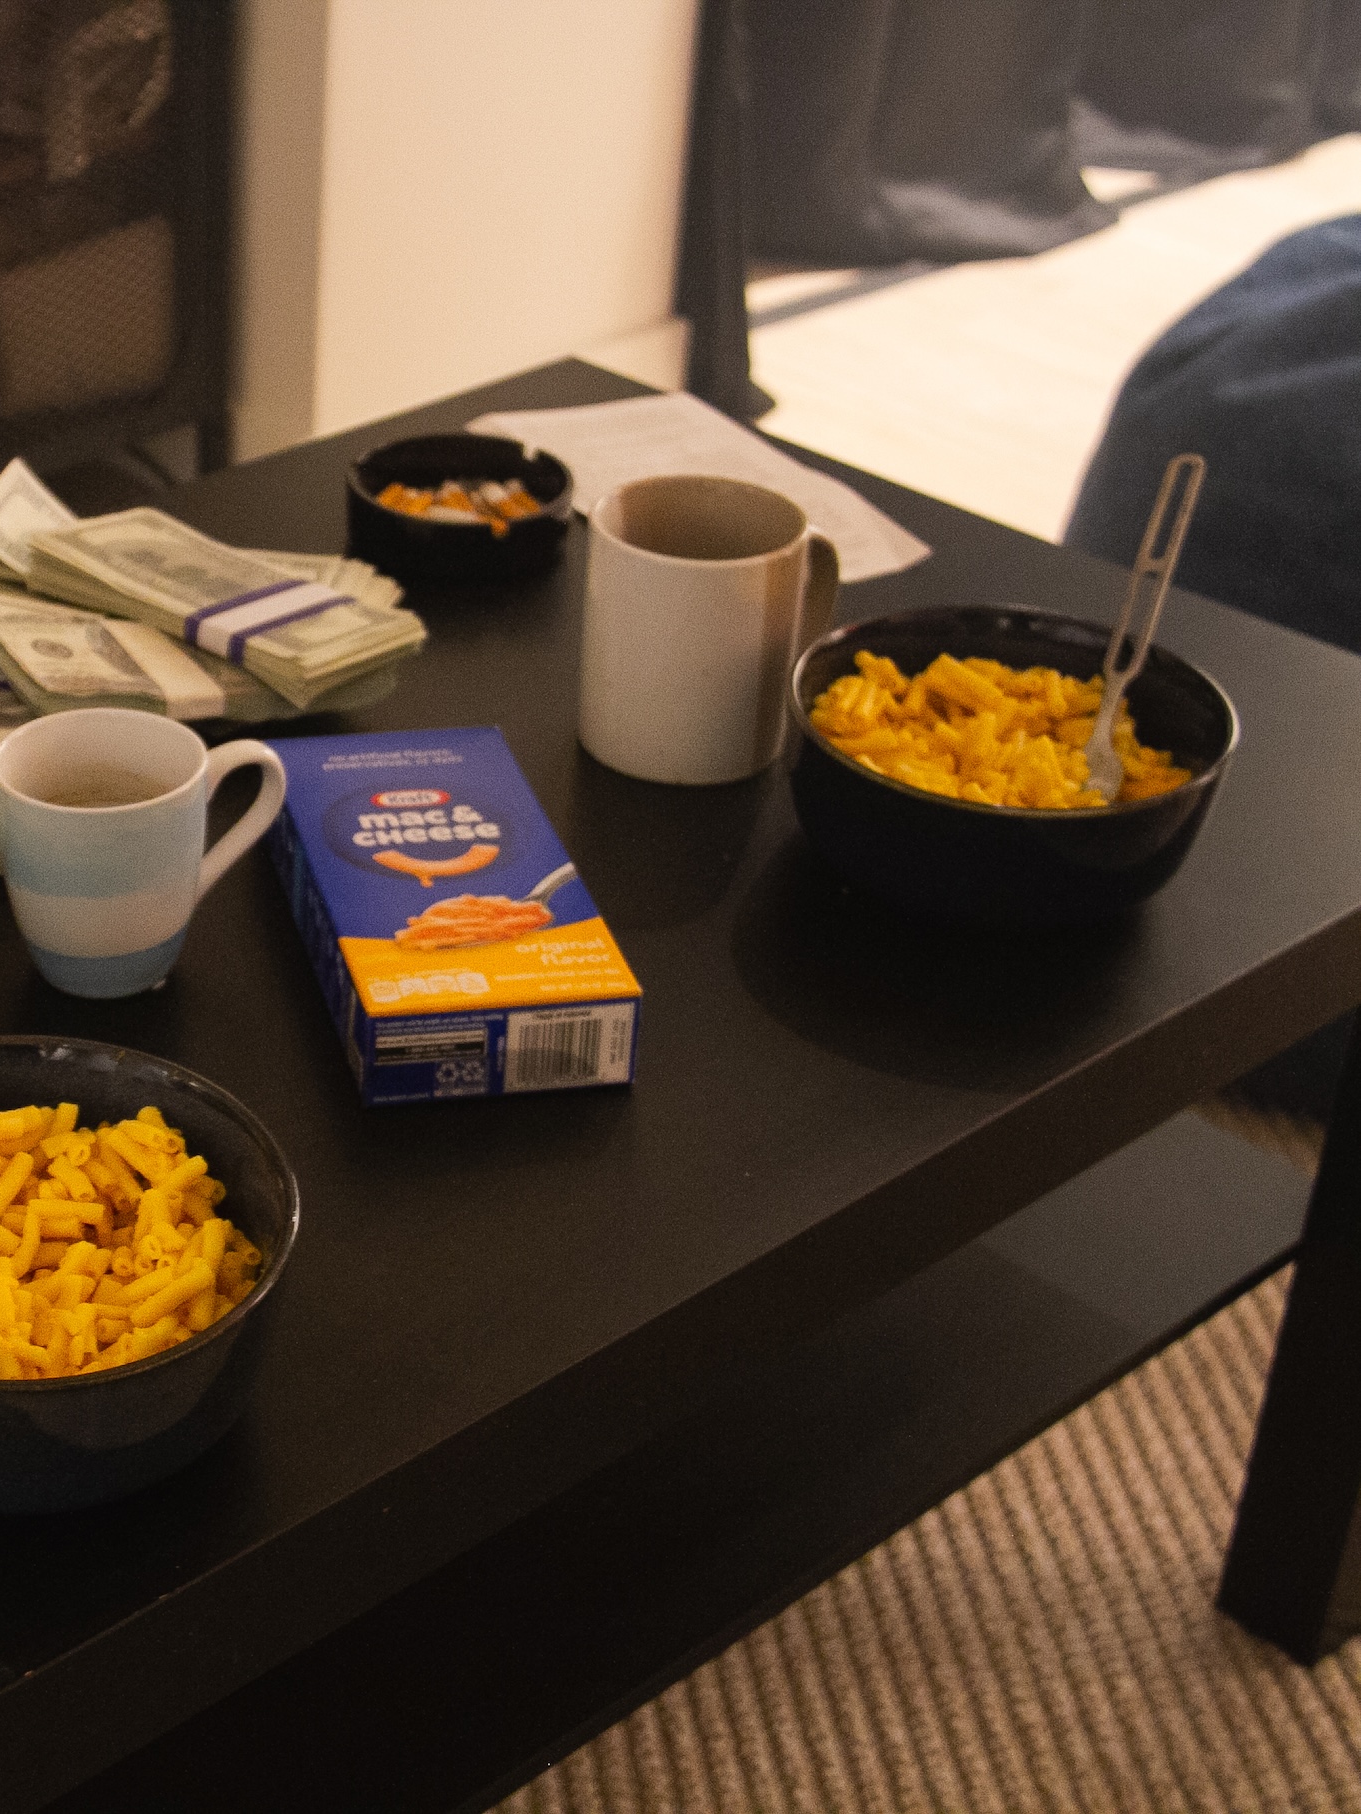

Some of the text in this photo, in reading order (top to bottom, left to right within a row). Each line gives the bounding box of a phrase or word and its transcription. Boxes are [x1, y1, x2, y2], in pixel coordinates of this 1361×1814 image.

[358, 809, 447, 830] mac
[516, 938, 605, 954] original
[541, 953, 610, 965] flavor
